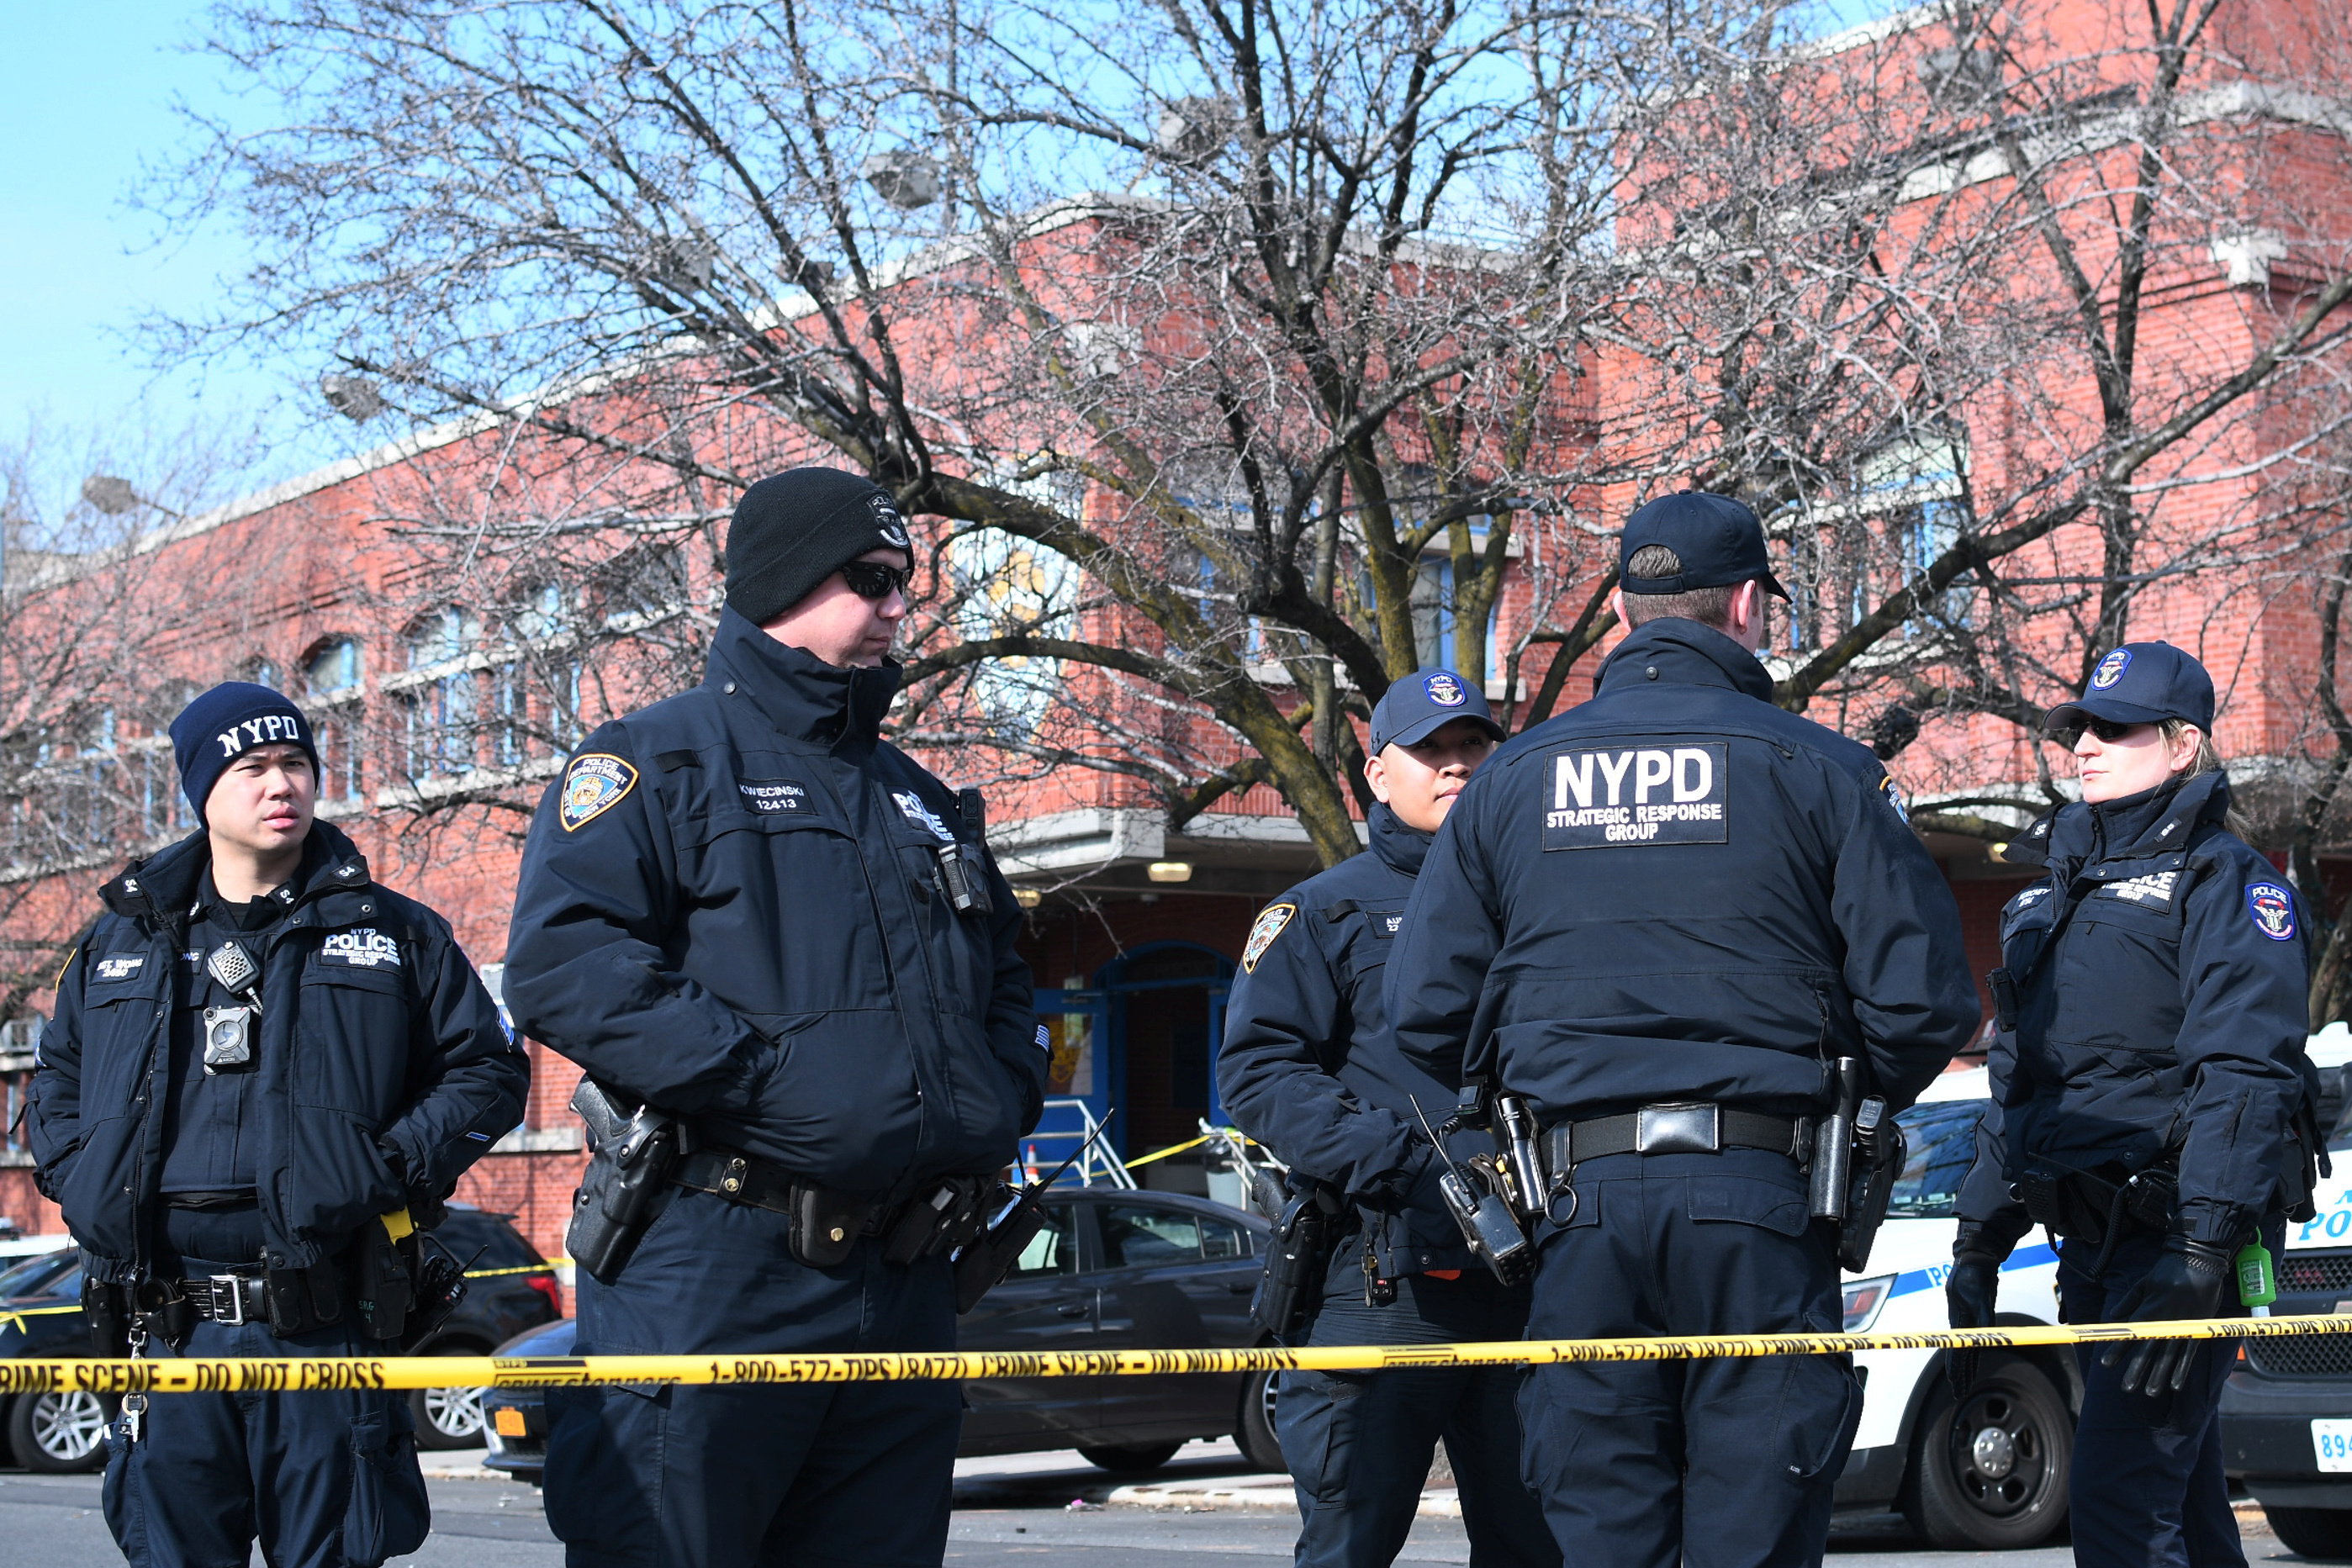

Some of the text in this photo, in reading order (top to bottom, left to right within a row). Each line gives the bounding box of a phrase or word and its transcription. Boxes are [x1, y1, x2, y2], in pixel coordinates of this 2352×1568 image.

[217, 715, 299, 757] NYPD
[583, 758, 620, 770] POLICE
[568, 766, 628, 784] DEPARTMENT
[1555, 748, 1713, 809] NYPD
[599, 787, 622, 805] YORK
[756, 799, 796, 810] 12413
[1547, 804, 1722, 828] STRATEGIC RESPONSE
[1605, 823, 1658, 842] GROUP
[339, 866, 355, 876] S4
[280, 890, 294, 904] S4
[2253, 886, 2287, 904] POLICE
[325, 934, 399, 957] POLICE
[348, 957, 378, 966] GROUP
[358, 1300, 375, 1311] SRG
[365, 1312, 372, 1323] 4
[1761, 1338, 1817, 1355] CRIME
[981, 1354, 1049, 1378] CRIME
[1056, 1352, 1124, 1376] SCENE
[75, 1364, 162, 1393] SCENE
[196, 1364, 232, 1391] DO
[240, 1363, 289, 1391] NOT
[300, 1362, 385, 1390] CROSS
